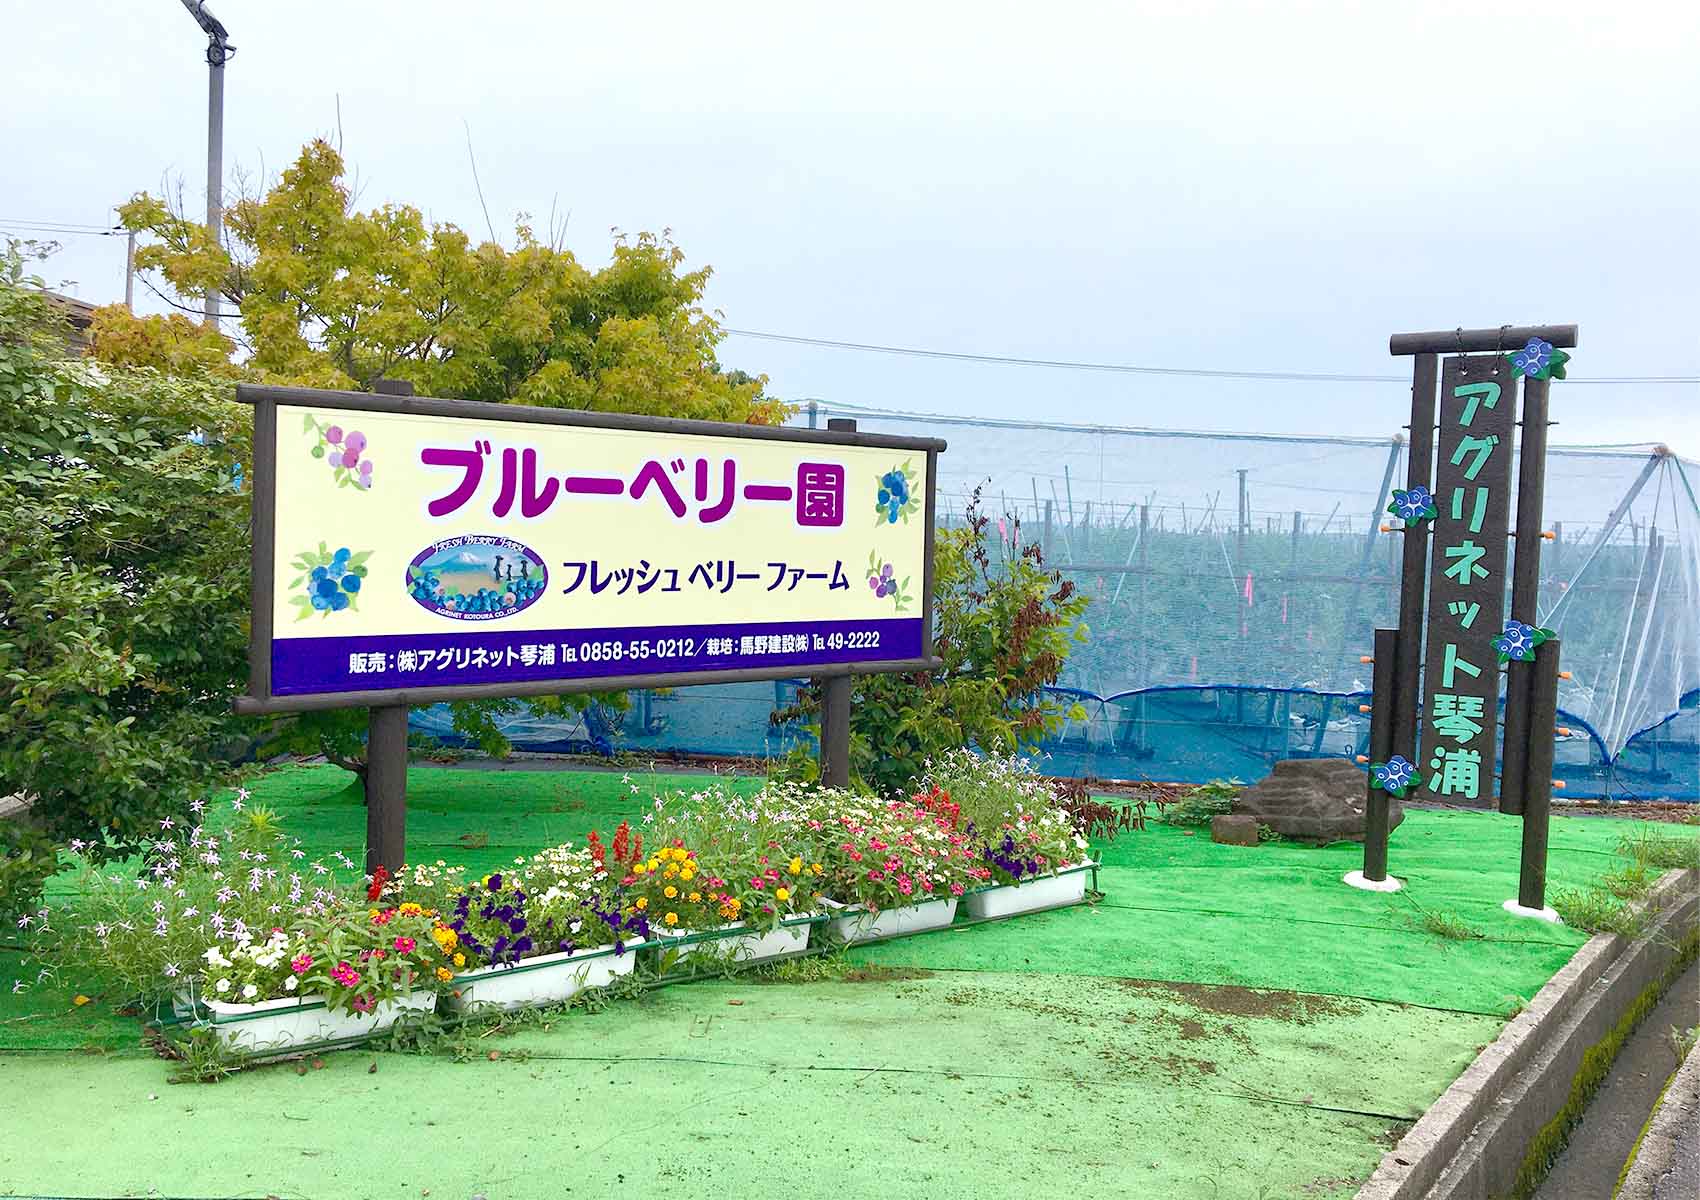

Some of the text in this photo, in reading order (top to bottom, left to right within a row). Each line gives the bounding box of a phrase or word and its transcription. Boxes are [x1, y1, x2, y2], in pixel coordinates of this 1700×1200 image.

[421, 440, 845, 527] ブルーベリー園
[432, 535, 526, 553] FRESH BERRY FARM
[562, 559, 850, 595] フレッシュ ベリー ファーム
[1428, 380, 1501, 799] アグリネット琴浦
